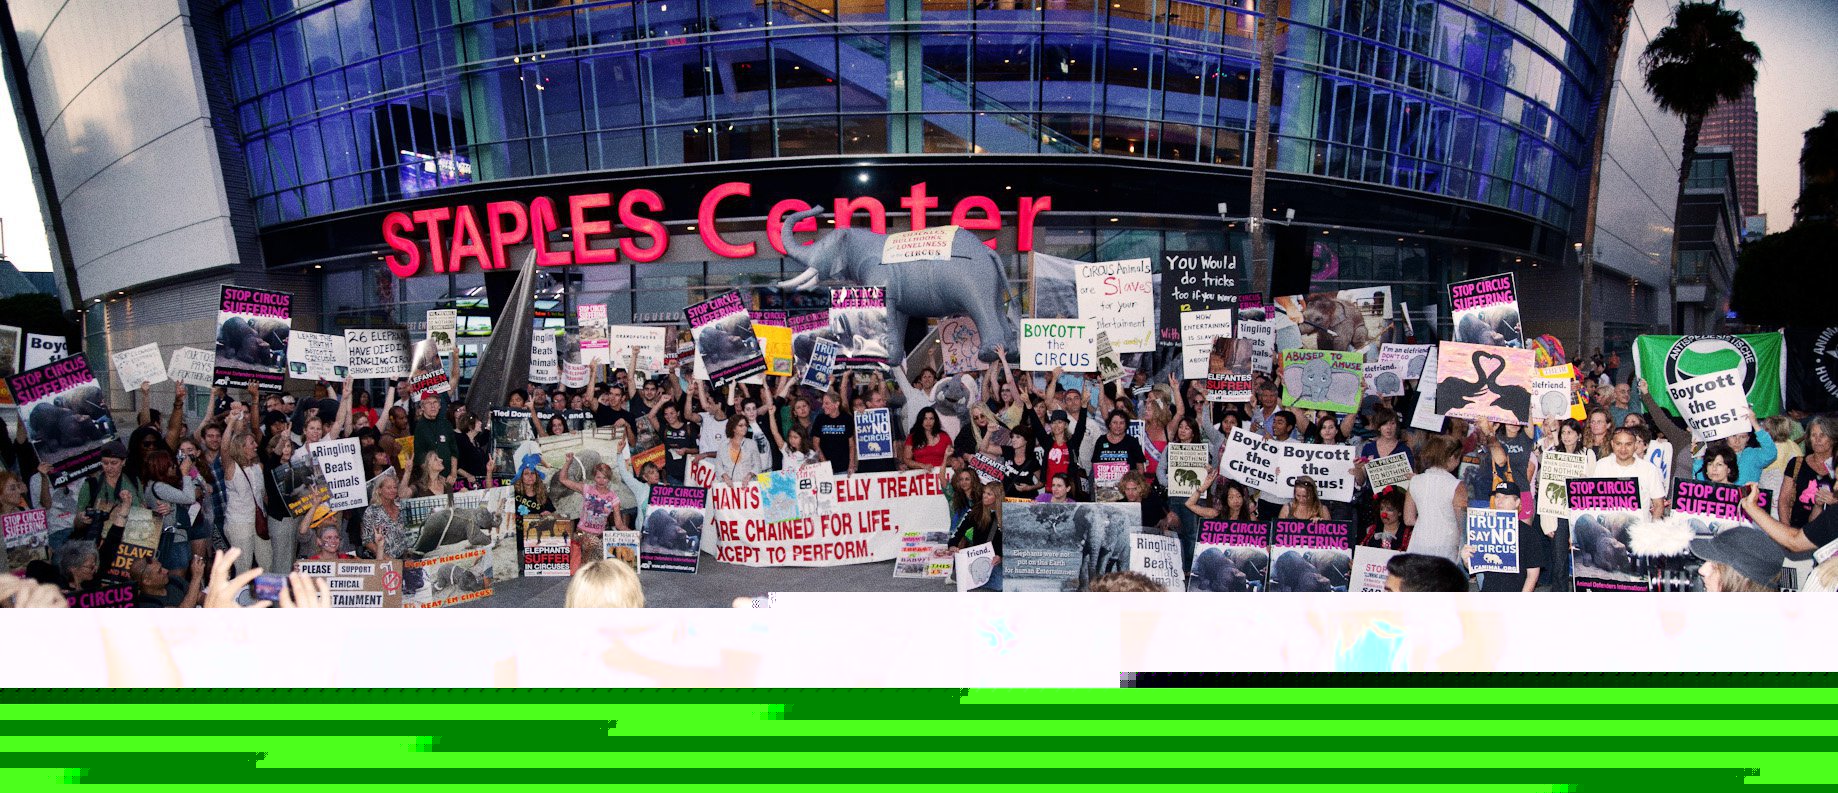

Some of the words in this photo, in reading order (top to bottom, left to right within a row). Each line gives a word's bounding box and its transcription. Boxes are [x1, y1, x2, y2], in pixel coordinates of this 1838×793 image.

[382, 189, 669, 277] STAPLES
[698, 181, 1052, 258] Center
[1082, 264, 1114, 278] CIRCUS
[1117, 260, 1151, 275] Animals
[1166, 255, 1197, 270] YOU
[1200, 255, 1236, 269] Would
[1104, 276, 1152, 296] Slaves
[1181, 271, 1196, 284] do
[1202, 271, 1234, 287] tricks
[1172, 286, 1189, 300] too
[1192, 290, 1201, 300] if
[1202, 291, 1215, 302] you
[1453, 284, 1474, 299] STOP
[1476, 277, 1511, 293] CIRCUS
[225, 288, 251, 301] STOP
[253, 291, 290, 307] CIRCUS
[1453, 290, 1514, 313] SUFFERING
[222, 300, 289, 319] SUFFERING
[688, 303, 708, 319] STOP
[708, 291, 739, 310] CIRCUS
[1118, 301, 1137, 312] your
[691, 302, 744, 329] SUFFERING
[788, 316, 804, 326] STOP
[1024, 323, 1085, 339] BOYCOTT
[1183, 322, 1230, 331] ENTERTAINING
[348, 331, 368, 343] 26
[349, 346, 371, 356] HAVE
[532, 346, 553, 355] Beats
[1047, 339, 1065, 350] the
[349, 356, 388, 366] RINGLING
[1034, 352, 1090, 367] CIRCUS
[1330, 352, 1342, 360] TO
[349, 367, 373, 375] SHOWS
[375, 366, 396, 374] SINCE
[1331, 360, 1361, 371] AMUSE
[11, 371, 42, 391] STOP
[44, 356, 87, 379] CIRCUS
[1207, 373, 1252, 381] ELEFANTES
[17, 369, 93, 406] SUFFERING
[1206, 380, 1252, 390] SUFREN
[1670, 373, 1735, 400] Boycott
[1688, 399, 1717, 415] the
[492, 410, 511, 418] Tied
[568, 410, 585, 419] and
[856, 413, 888, 424] TRUTH
[857, 425, 871, 434] SAY
[872, 422, 889, 434] NO
[863, 434, 890, 442] CIRCUS
[1232, 430, 1279, 454] Boyco
[316, 443, 356, 457] Ringling
[1283, 446, 1351, 462] Boycott
[1246, 451, 1271, 468] the
[324, 461, 353, 474] Beats
[970, 457, 1005, 481] SUFREN
[1097, 465, 1110, 473] STOP
[1110, 465, 1129, 473] CIRCUS
[1229, 458, 1279, 485] Circus!
[1301, 463, 1330, 476] the
[1380, 467, 1410, 479] NOTHING
[652, 486, 674, 496] STOP
[675, 487, 705, 499] CIRCUS
[836, 478, 871, 503] ELLY
[1570, 482, 1595, 495] STOP
[1597, 481, 1636, 495] CIRCUS
[1678, 482, 1710, 499] STOP
[1716, 486, 1767, 507] CIRS
[515, 495, 541, 511] CIRCOS
[650, 496, 704, 509] SUFFERING
[1570, 495, 1639, 511] SUFFERING
[3, 514, 21, 527] STOP
[22, 510, 45, 523] CIRCUS
[1469, 515, 1516, 529] TRUTH
[5, 521, 47, 538] SUFFERING
[745, 517, 815, 543] CHAINED
[821, 512, 852, 538] FOR
[858, 509, 899, 534] LIFE,
[1203, 521, 1227, 533] STOP
[1230, 522, 1267, 535] CIRCUS
[1276, 521, 1304, 534] STOP
[1307, 523, 1348, 536] CIRCUS
[1200, 533, 1267, 549] SUFFERING
[1275, 533, 1349, 550] SUFFERING
[1469, 531, 1490, 541] SAY
[1491, 528, 1516, 545] NO
[767, 546, 787, 564] TO
[792, 539, 875, 562] PERFORM.
[1013, 549, 1042, 558] Elephants
[1477, 544, 1516, 553] CIRCUS
[525, 554, 570, 564] SUFFER
[1143, 556, 1174, 570] Beats
[302, 564, 332, 575] PLEASE
[341, 565, 371, 573] SUPPORT
[525, 563, 533, 571] IN
[533, 563, 570, 571] CIRCUSES
[330, 579, 360, 589] ETHICAL
[1592, 581, 1616, 590] Defenders
[1616, 583, 1648, 591] International
[80, 586, 134, 608] CIRCUS
[421, 600, 442, 608] BEAT
